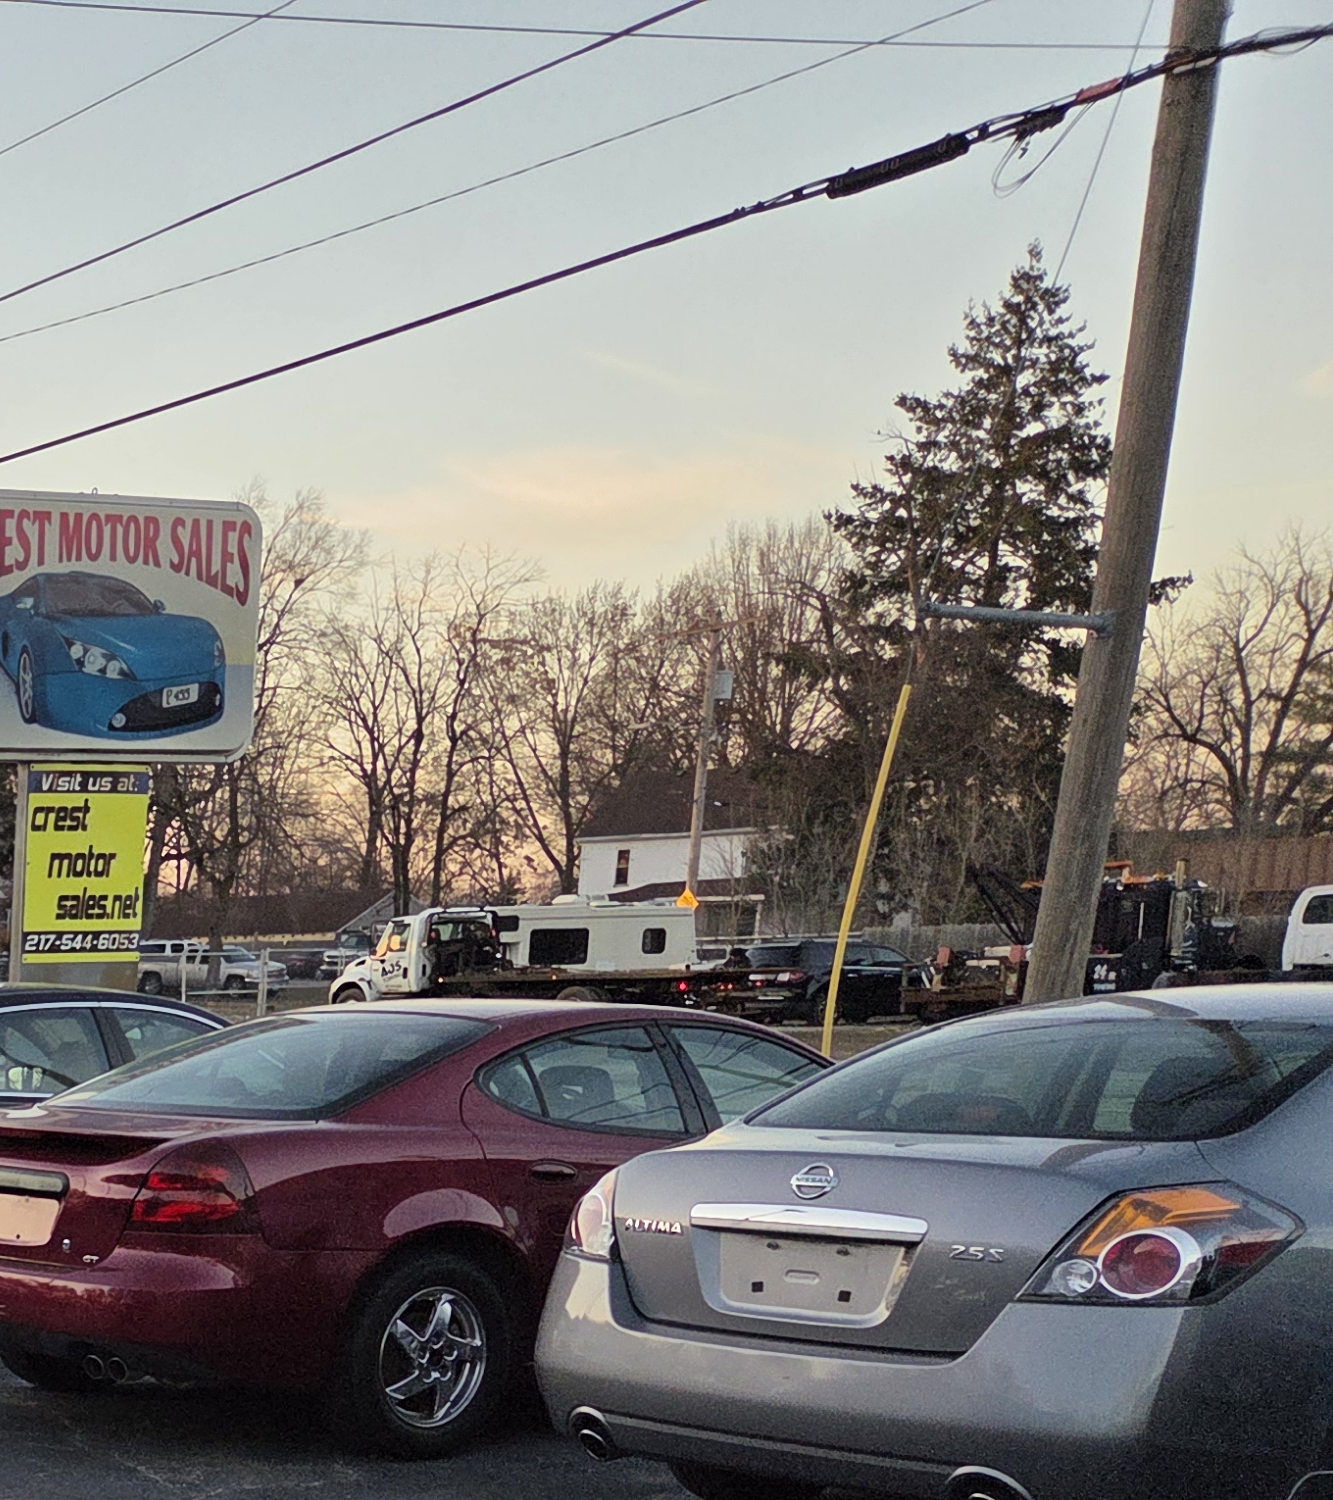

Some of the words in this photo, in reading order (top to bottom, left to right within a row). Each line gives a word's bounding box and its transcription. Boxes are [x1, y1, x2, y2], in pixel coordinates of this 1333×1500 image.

[58, 511, 161, 568] MOTOR
[169, 516, 253, 607] SALES
[41, 773, 83, 791] Visit
[88, 776, 113, 791] us
[30, 798, 91, 832] crest
[47, 844, 117, 878] motor
[55, 886, 140, 920] sales.net
[24, 933, 140, 951] 217-544-6053
[625, 1218, 682, 1233] ALTIMA
